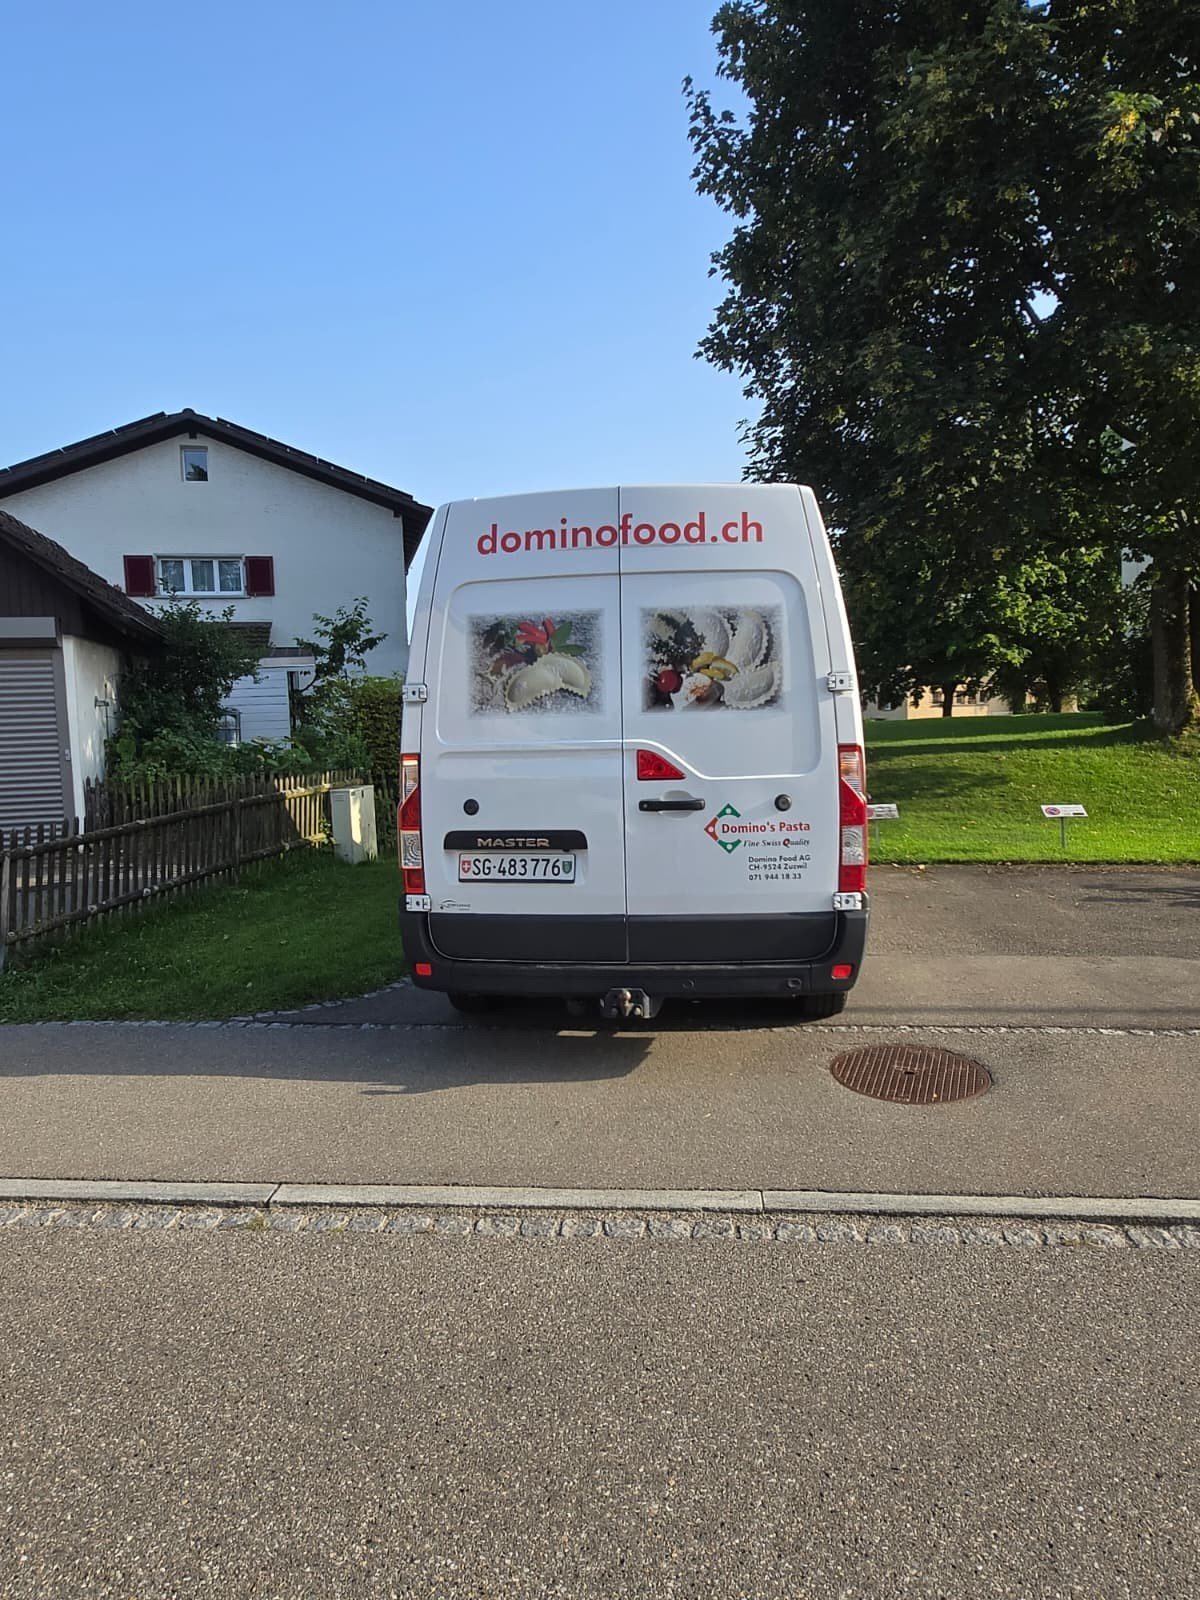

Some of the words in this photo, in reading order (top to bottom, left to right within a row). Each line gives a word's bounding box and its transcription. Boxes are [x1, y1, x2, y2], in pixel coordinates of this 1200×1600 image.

[477, 511, 763, 555] dominofood.ch
[722, 822, 776, 833] Domino's
[780, 822, 811, 832] Pasta
[477, 838, 550, 847] MASTER
[743, 839, 760, 847] Fine
[761, 839, 781, 847] Swiss
[782, 838, 810, 848] Quality
[748, 863, 782, 871] CH-9524
